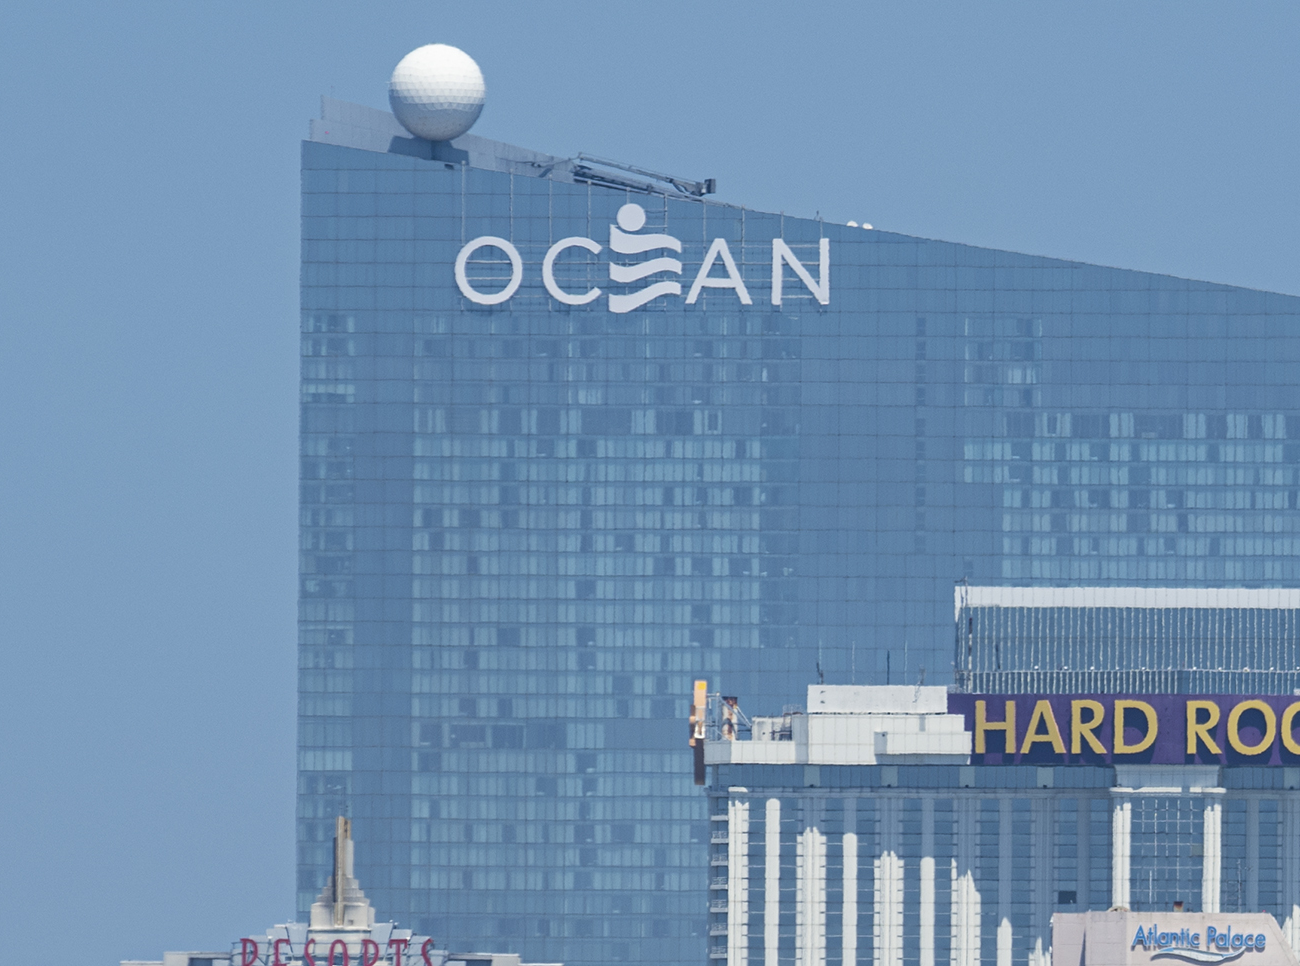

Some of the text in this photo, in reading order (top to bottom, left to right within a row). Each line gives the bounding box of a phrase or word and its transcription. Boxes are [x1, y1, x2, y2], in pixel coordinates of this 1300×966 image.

[454, 204, 830, 314] OCEAN
[974, 699, 1159, 755] HARD
[1131, 924, 1267, 948] Atlantic Palace
